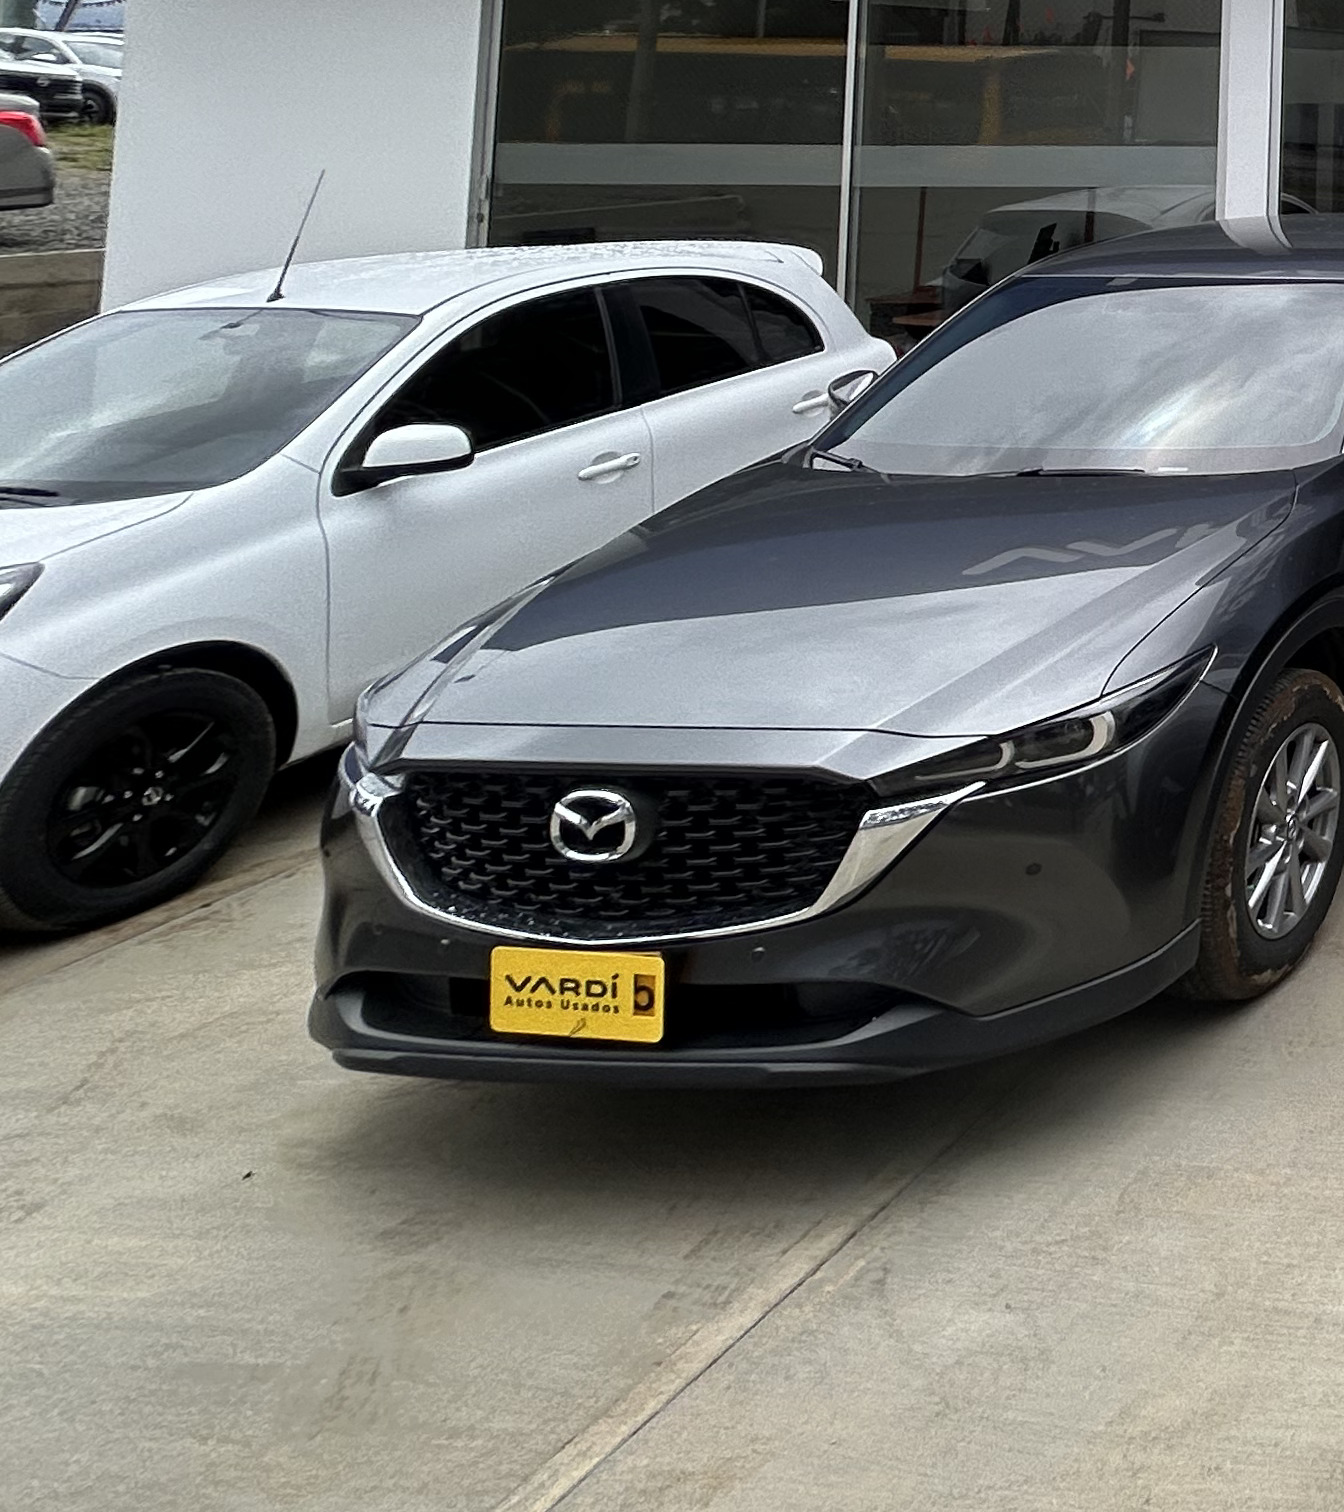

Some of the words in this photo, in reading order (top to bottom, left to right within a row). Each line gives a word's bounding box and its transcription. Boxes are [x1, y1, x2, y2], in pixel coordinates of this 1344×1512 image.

[504, 973, 620, 1000] VARDÍ
[503, 995, 553, 1010] Autos
[560, 998, 620, 1015] Usados
